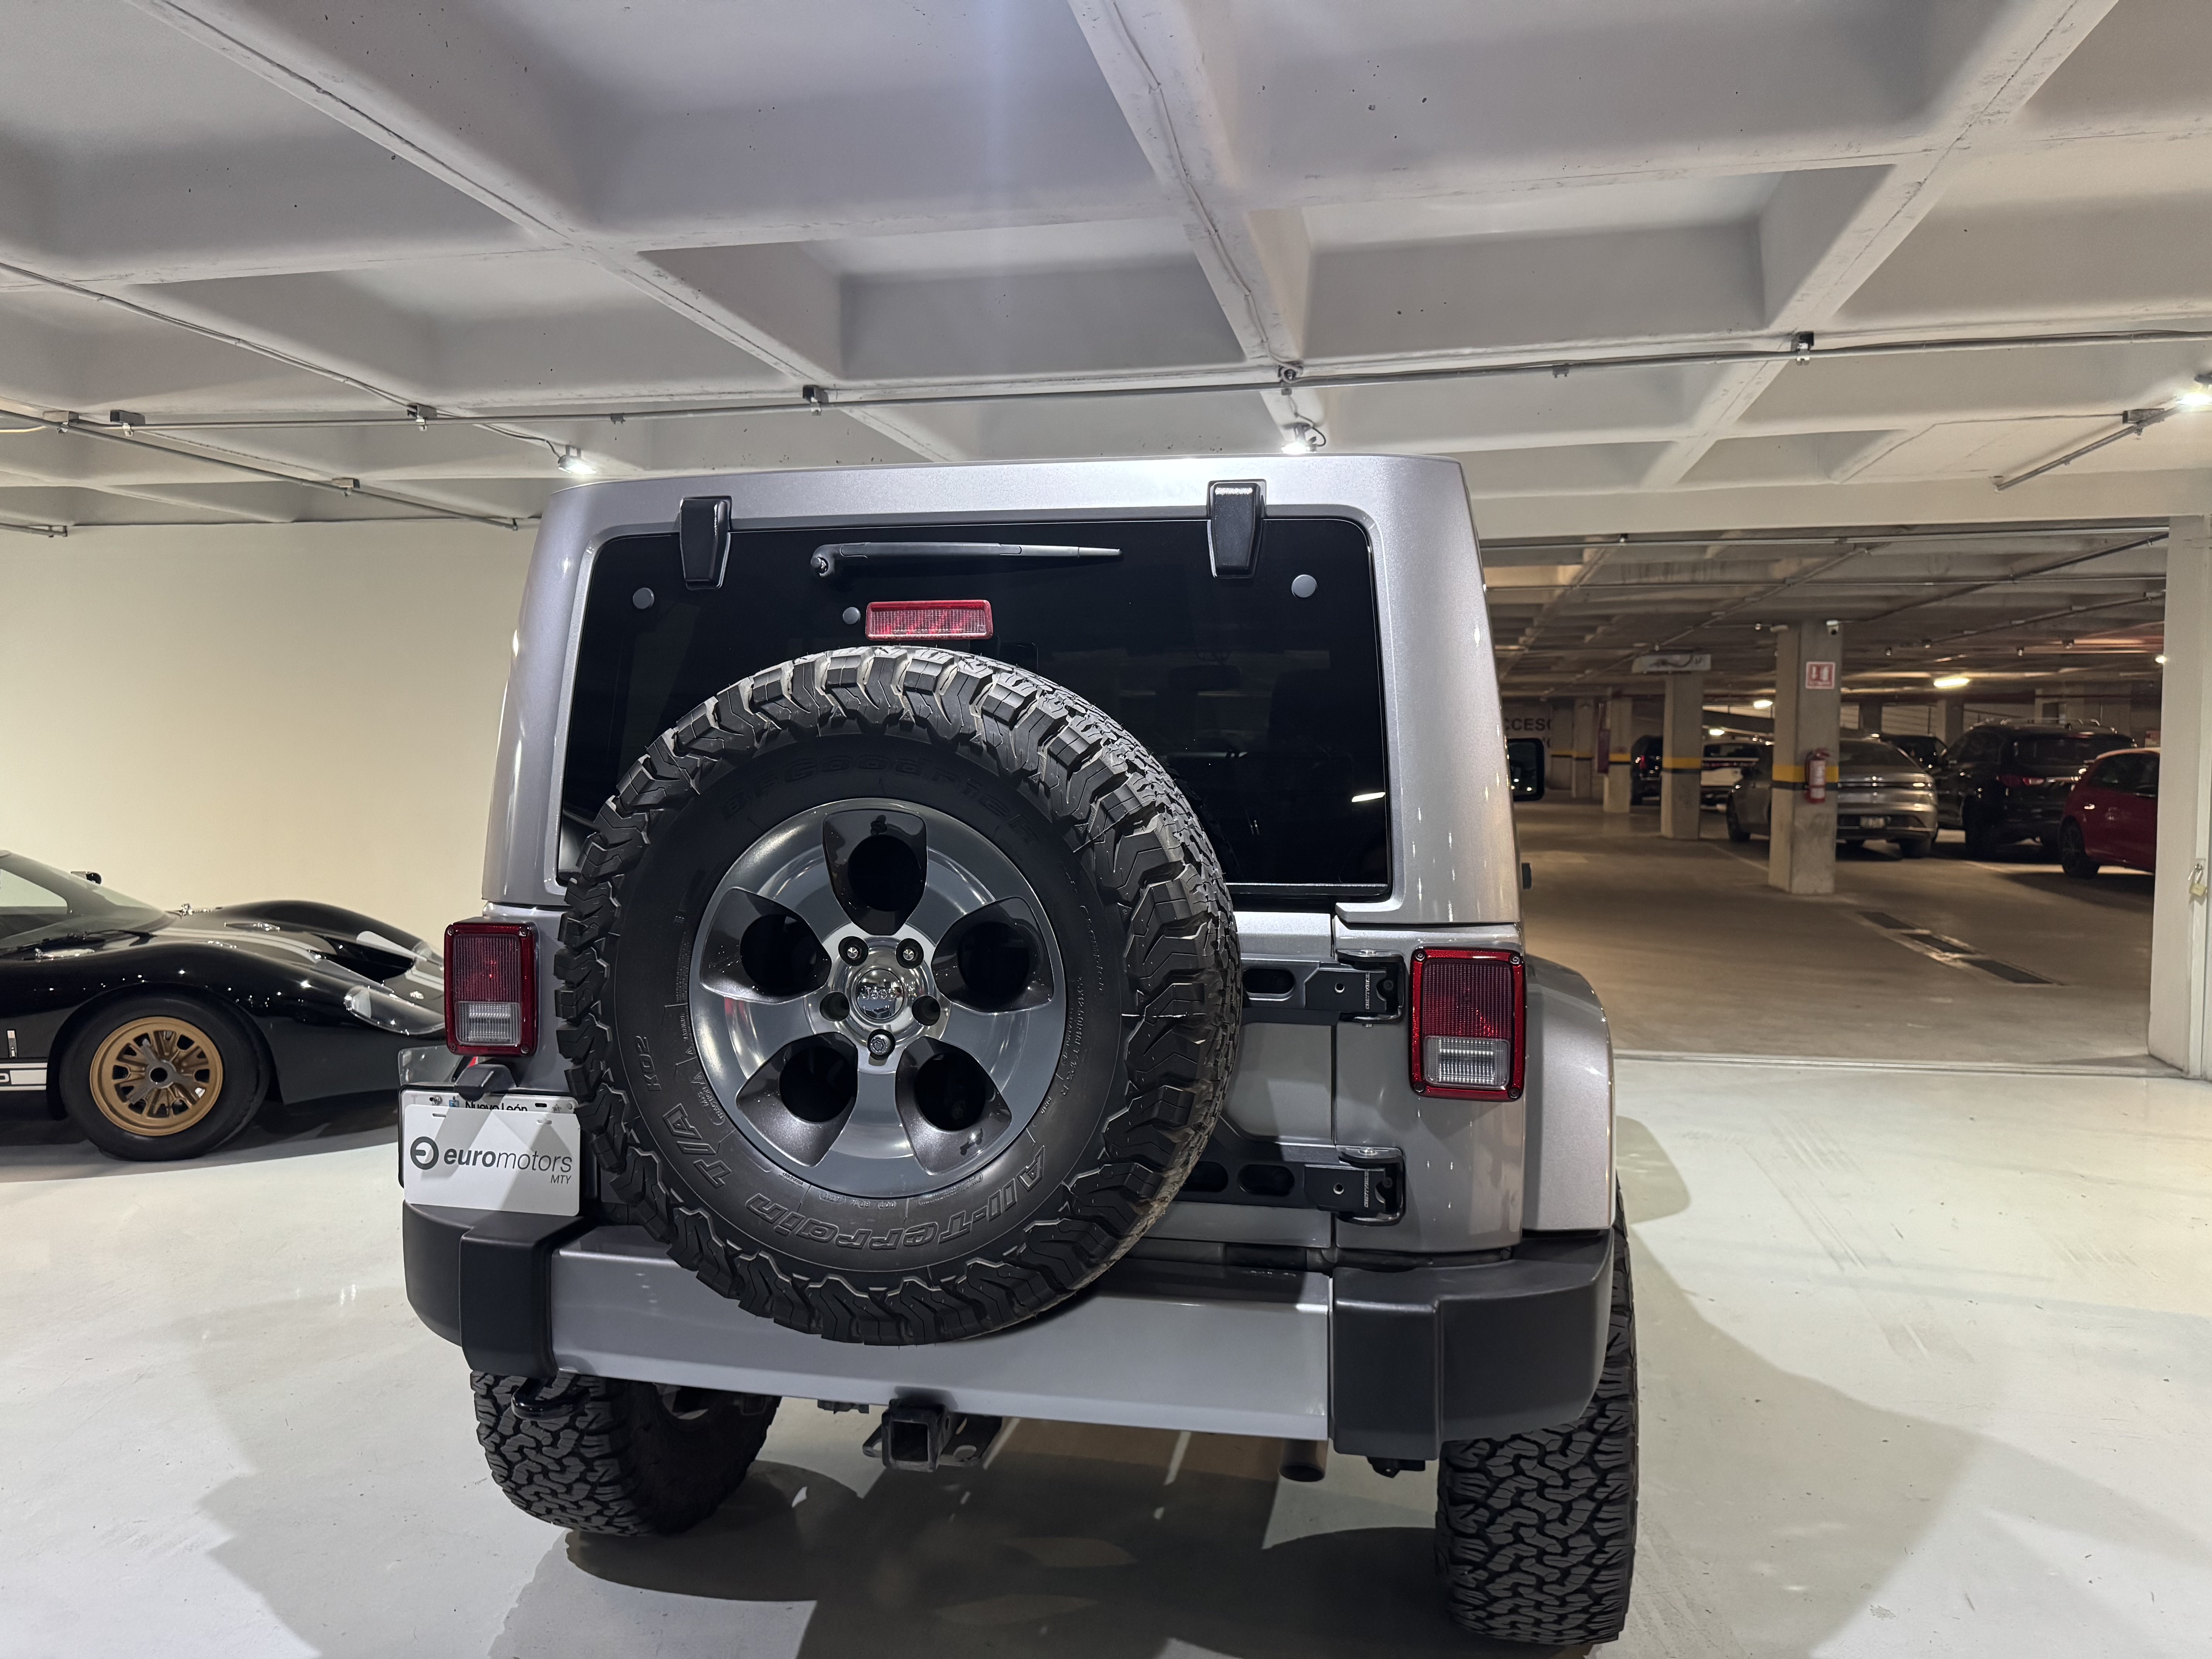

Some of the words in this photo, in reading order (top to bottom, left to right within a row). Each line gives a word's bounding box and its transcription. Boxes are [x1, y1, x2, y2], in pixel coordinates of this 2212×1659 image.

[721, 755, 1041, 846] BFGoodrich
[858, 985, 897, 1001] Jeep
[634, 1036, 662, 1090] KO2
[444, 1148, 572, 1173] euromotors
[662, 1103, 732, 1189] T/A
[551, 1175, 572, 1185] MTY
[745, 1145, 1045, 1250] All-Terrain
